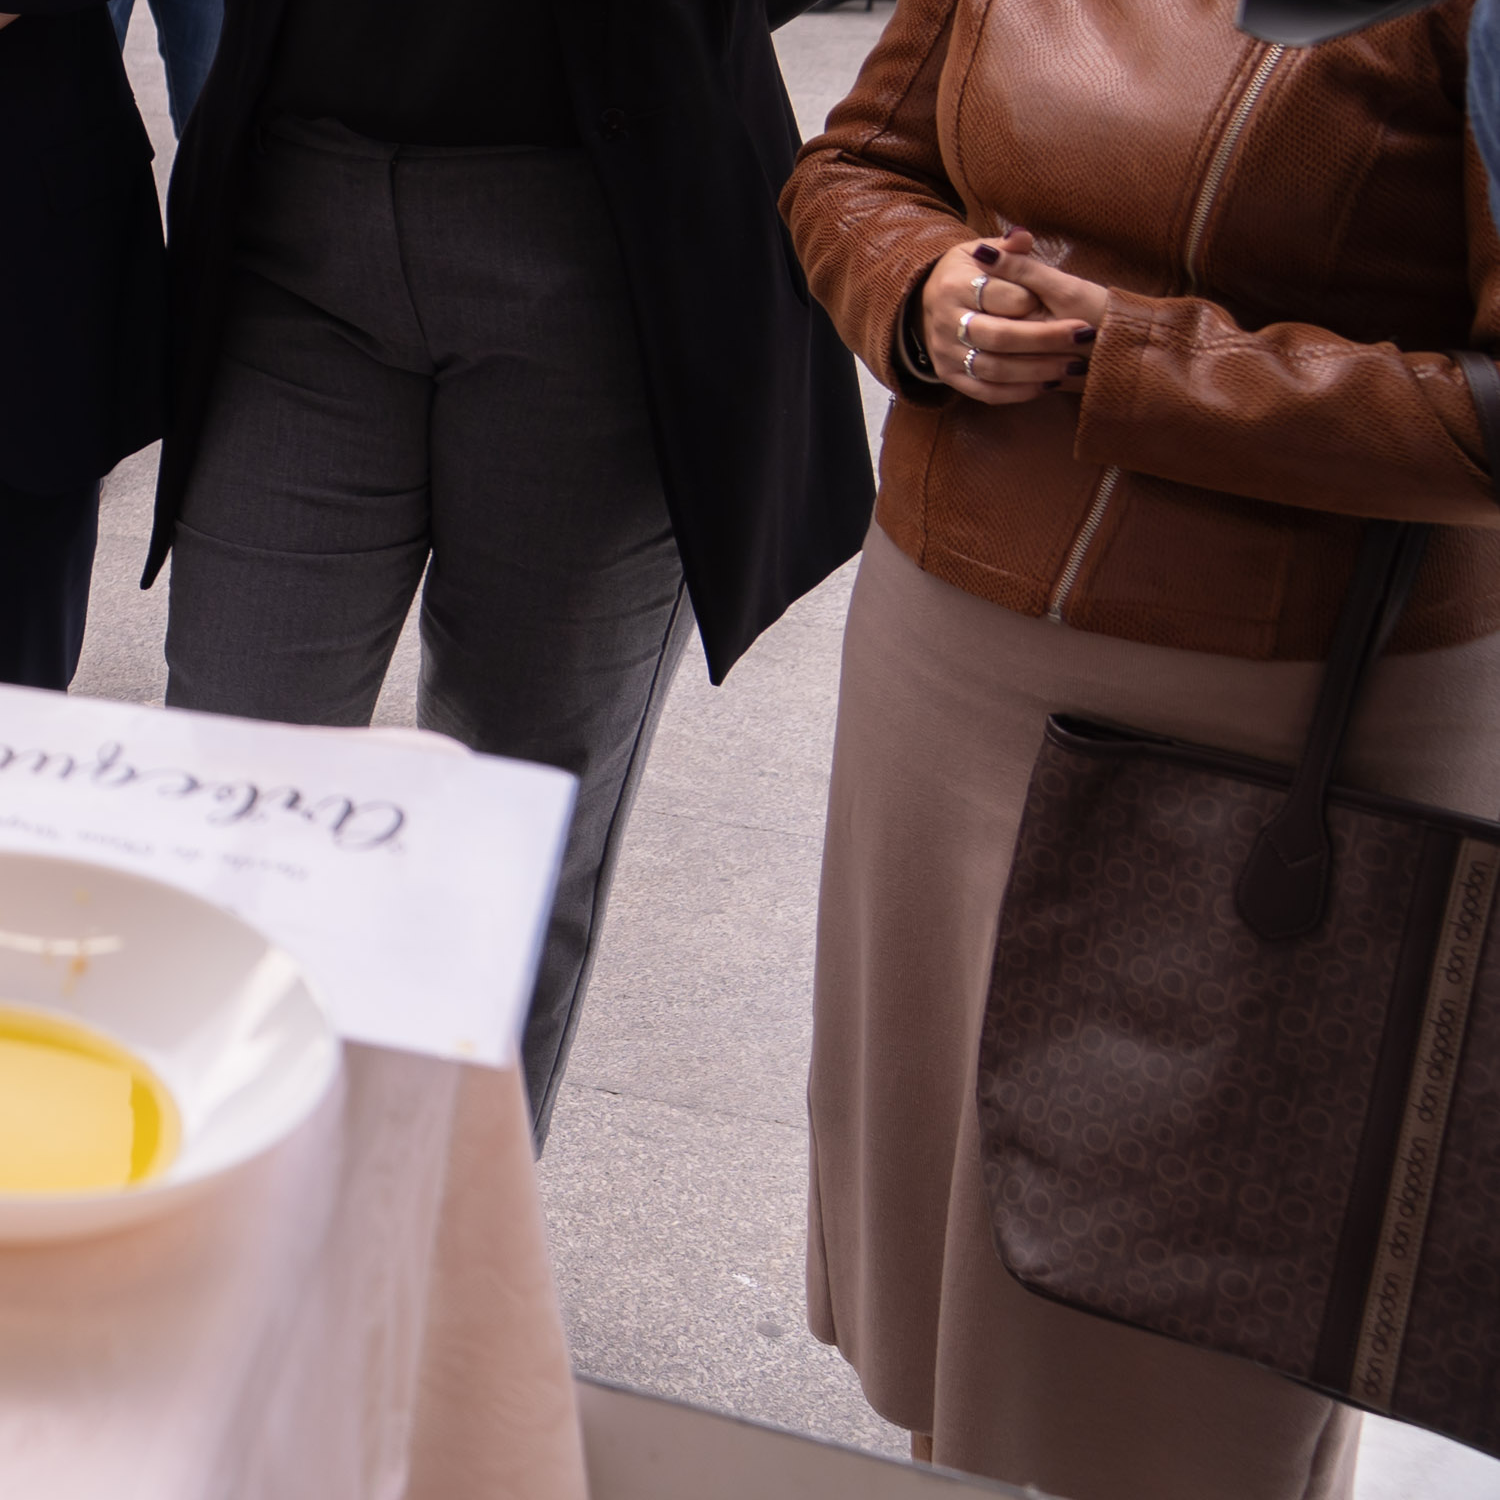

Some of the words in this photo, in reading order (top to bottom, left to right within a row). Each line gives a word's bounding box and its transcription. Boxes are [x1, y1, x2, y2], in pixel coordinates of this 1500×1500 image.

[1442, 946, 1466, 984] don
[1411, 1084, 1438, 1122] don
[1390, 1221, 1410, 1260] don
[1360, 1357, 1383, 1397] don
